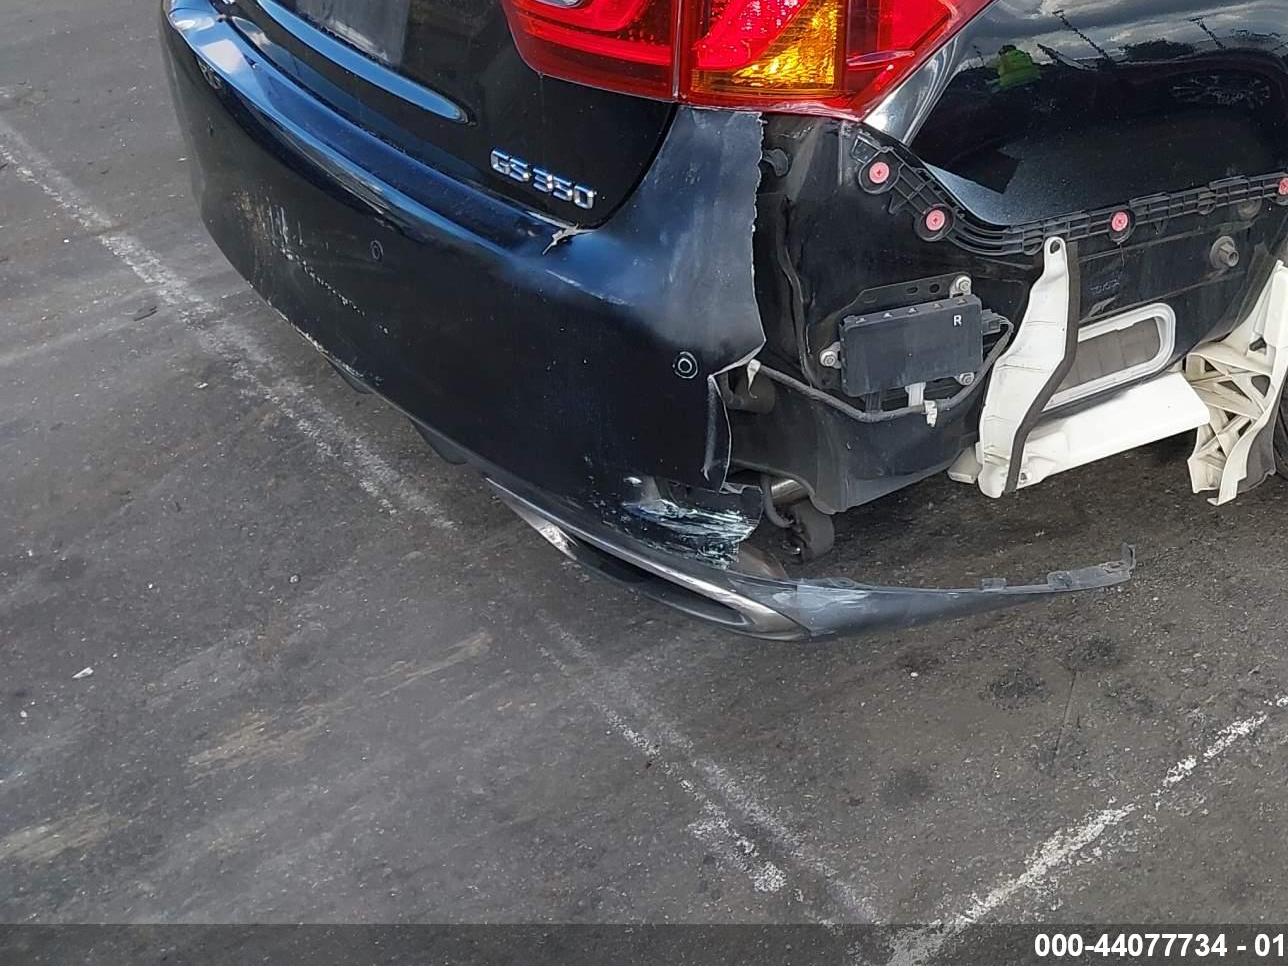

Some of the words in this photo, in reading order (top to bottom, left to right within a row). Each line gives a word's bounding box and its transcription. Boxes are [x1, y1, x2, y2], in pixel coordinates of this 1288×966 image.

[490, 149, 530, 183] GS
[533, 166, 595, 209] 350
[953, 314, 962, 326] R
